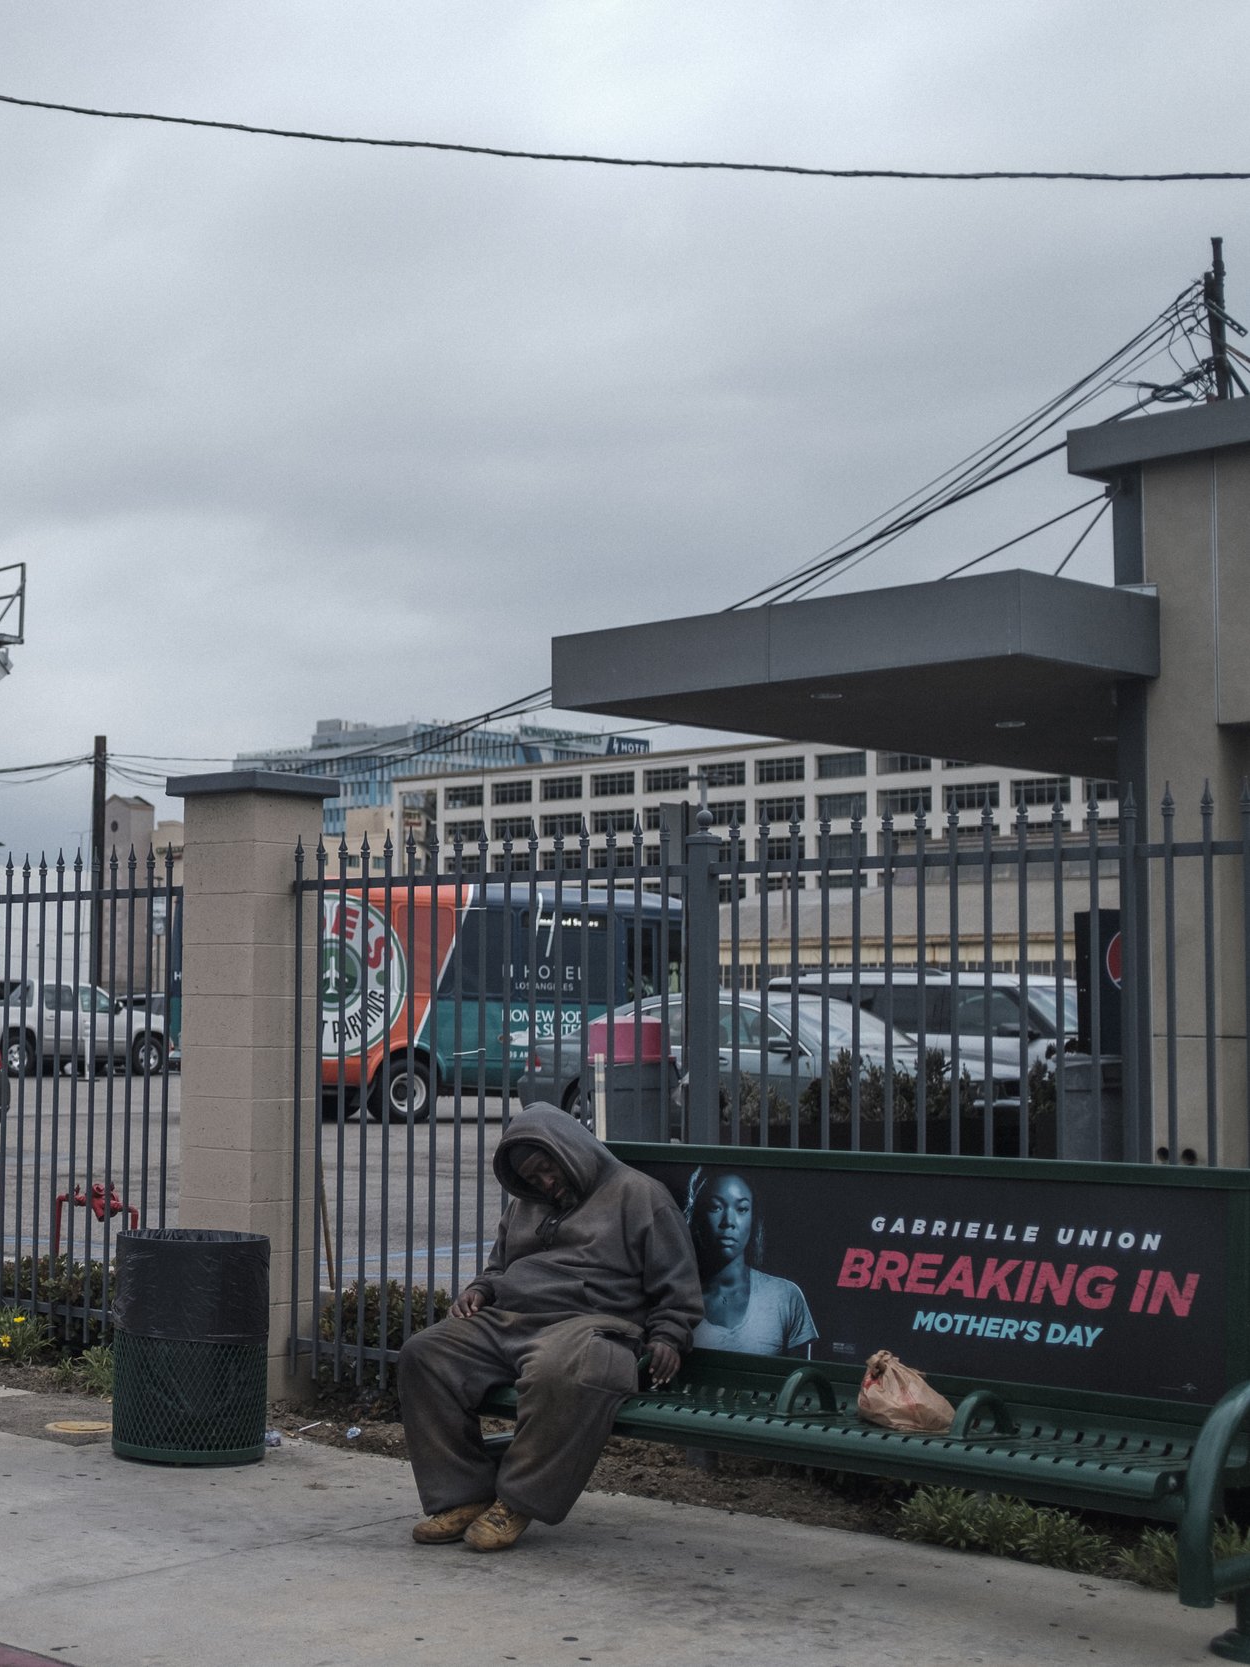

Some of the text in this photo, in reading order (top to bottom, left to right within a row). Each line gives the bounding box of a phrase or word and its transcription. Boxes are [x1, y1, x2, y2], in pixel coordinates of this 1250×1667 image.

[870, 1216, 1162, 1251] GABRIELLE UNION
[836, 1247, 1200, 1318] BREAKING IN
[912, 1310, 1103, 1349] MOTHER'S DAY
